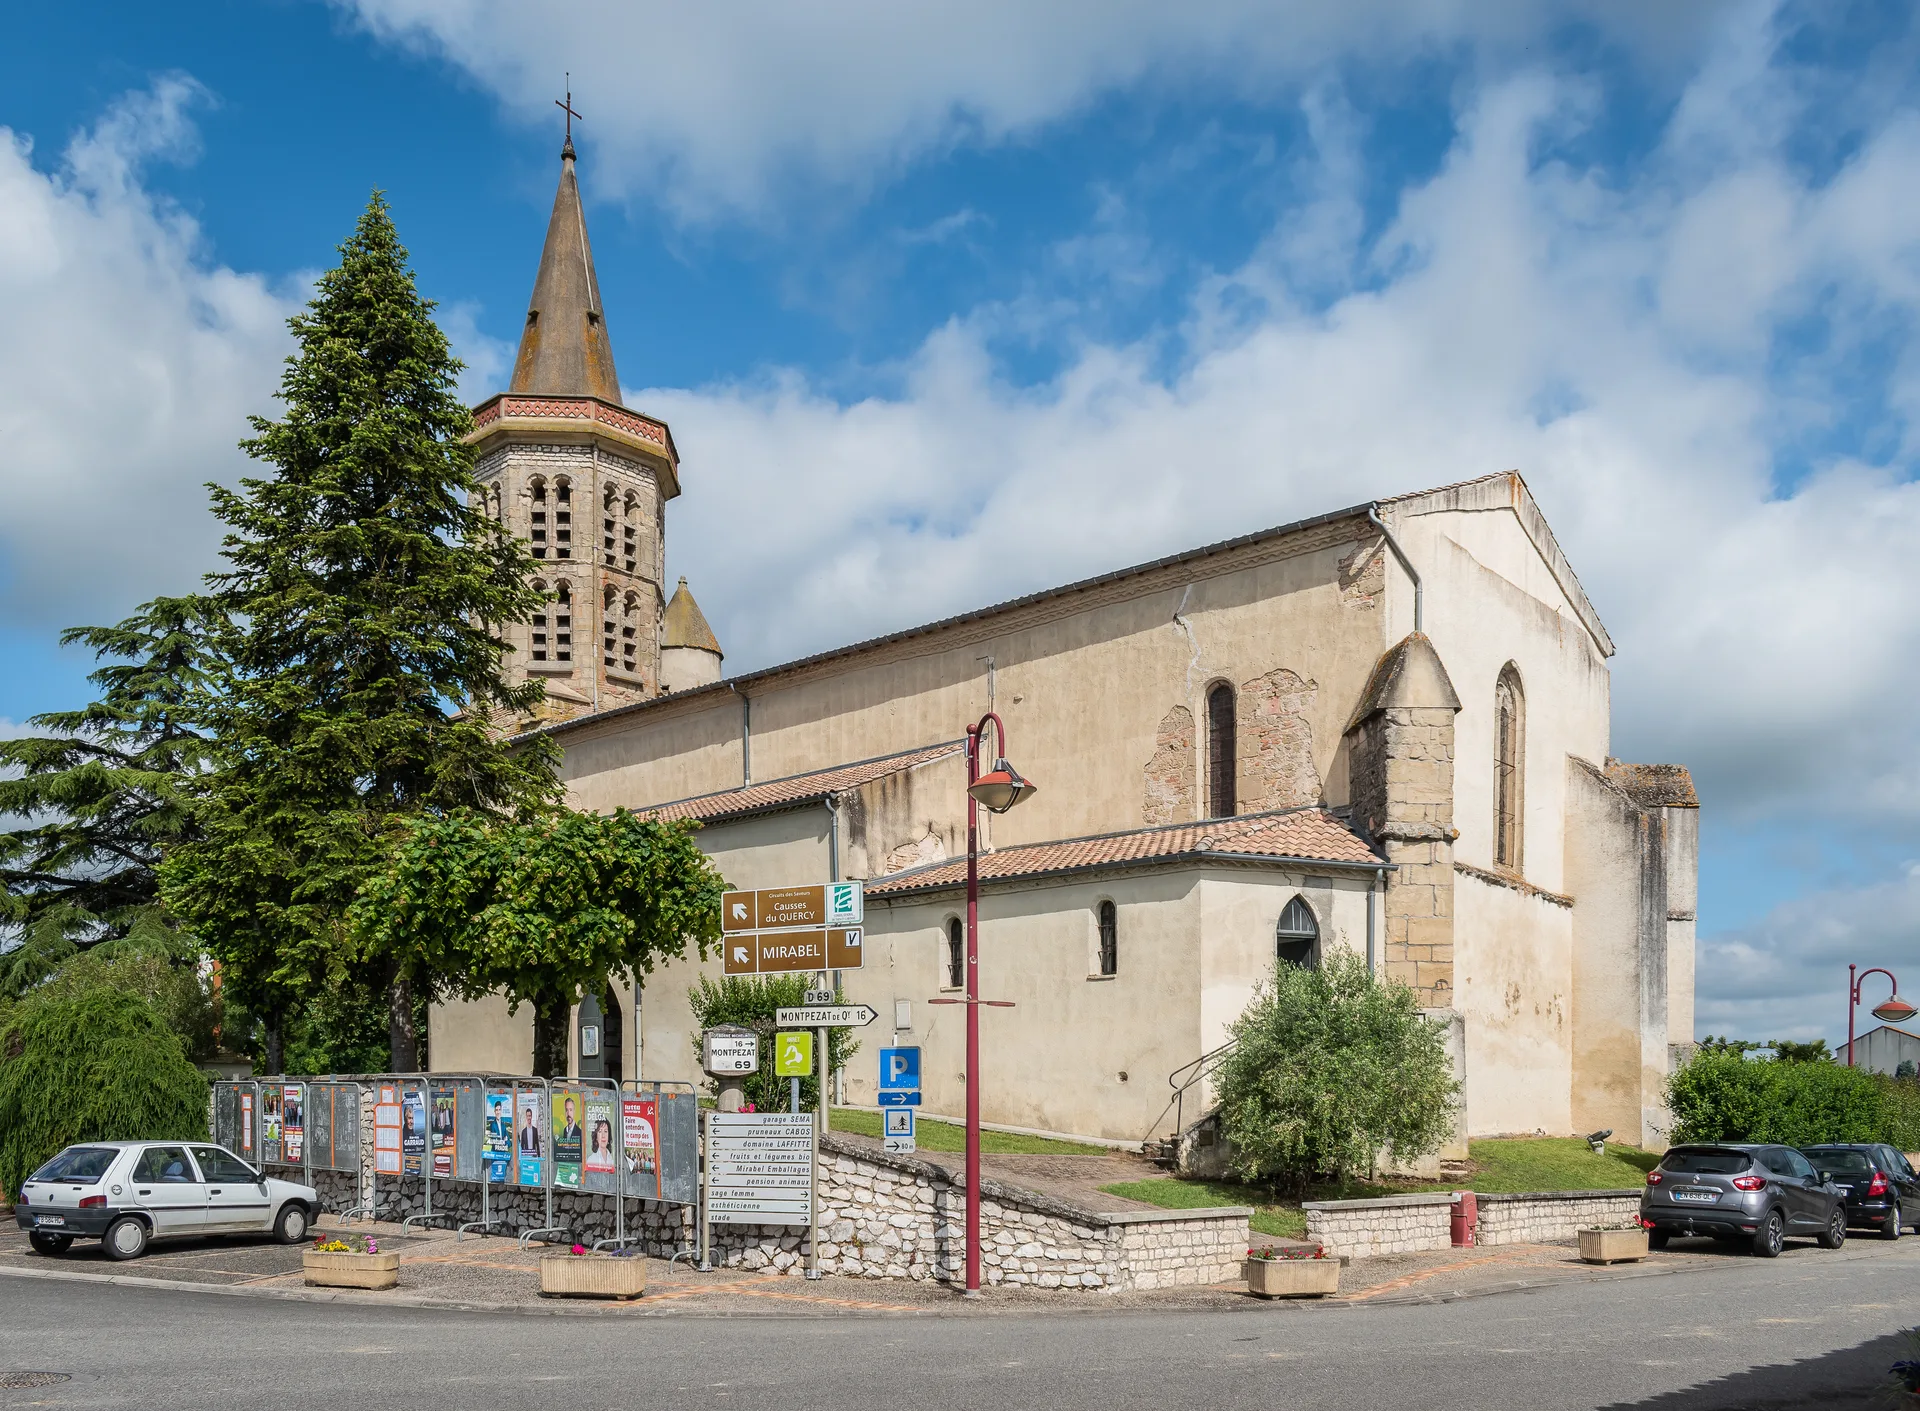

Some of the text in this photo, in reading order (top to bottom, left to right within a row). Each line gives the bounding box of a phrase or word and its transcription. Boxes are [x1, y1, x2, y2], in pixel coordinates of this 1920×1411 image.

[774, 902, 807, 911] Causses
[765, 911, 815, 923] du QUERCY
[849, 932, 857, 945] V
[763, 944, 820, 959] MIRABEL
[808, 992, 830, 1002] D 69
[781, 1012, 831, 1021] MONTPEZAT
[857, 1010, 866, 1020] 16
[735, 1061, 751, 1069] 69
[890, 1056, 908, 1082] P
[587, 1105, 610, 1114] CAROLE
[587, 1113, 607, 1121] DELGA
[763, 1116, 787, 1124] garage
[765, 1153, 794, 1161] légumes
[768, 1166, 810, 1174] Emballages
[746, 1178, 775, 1186] pension
